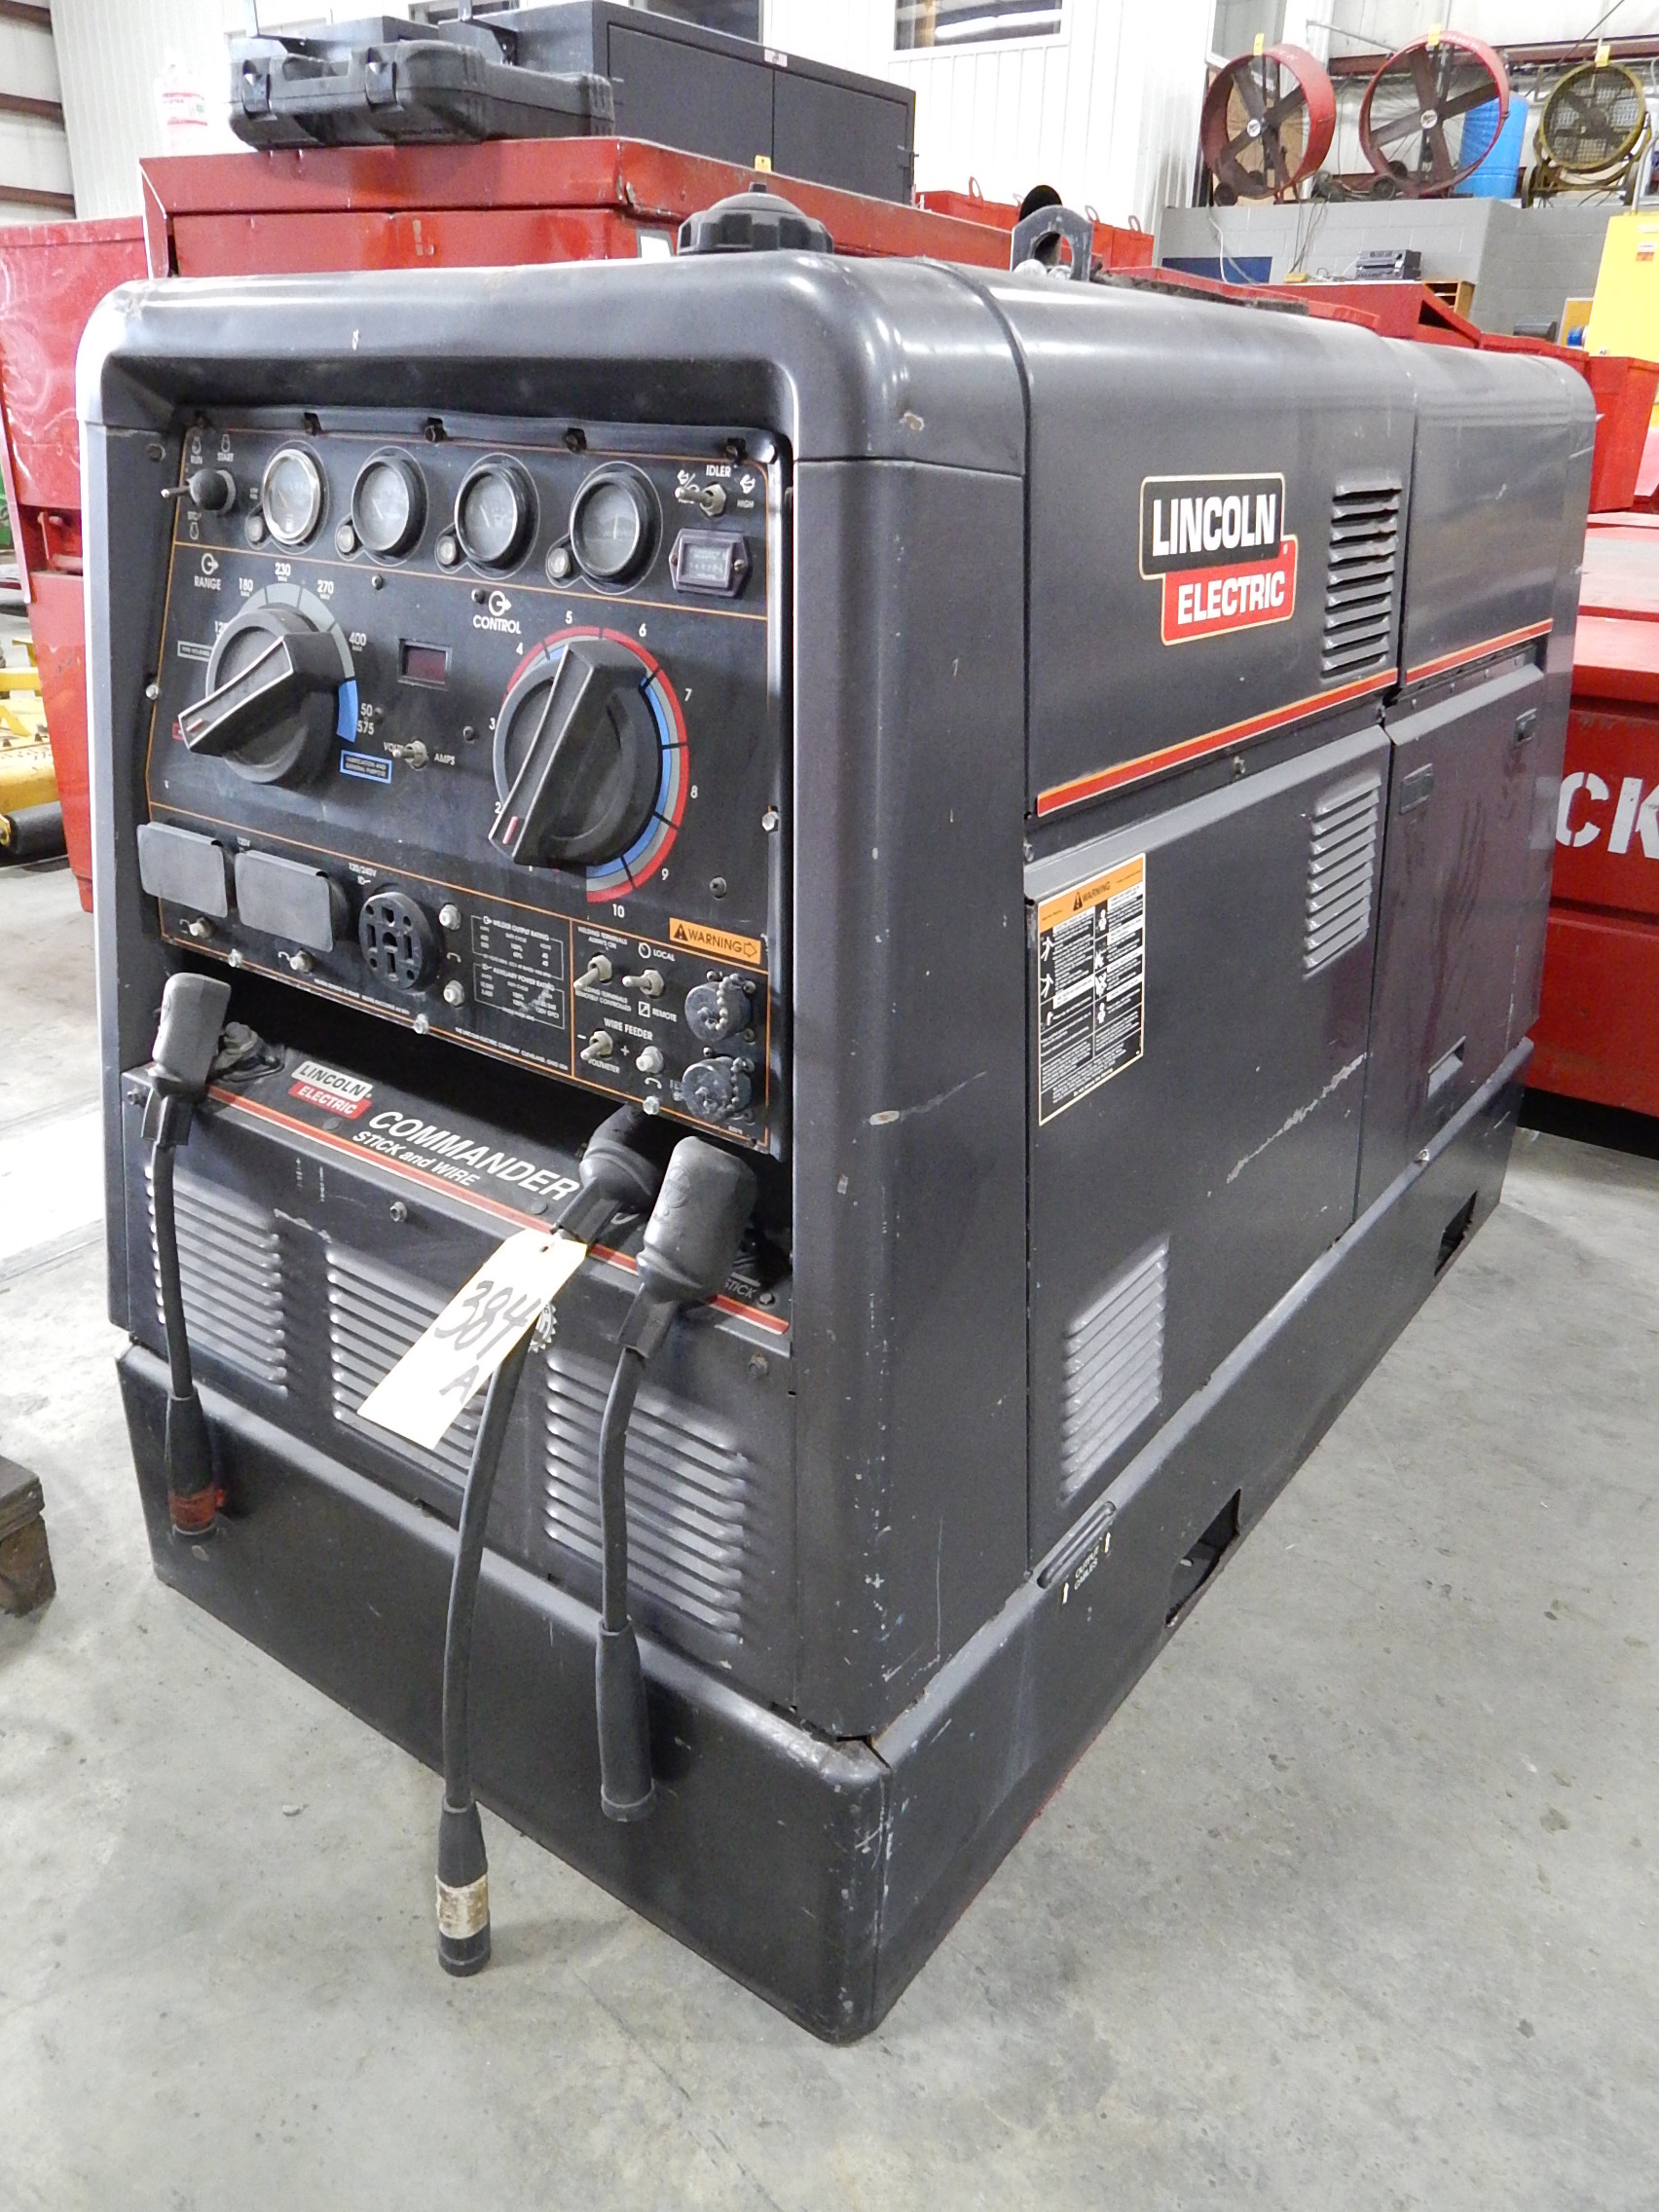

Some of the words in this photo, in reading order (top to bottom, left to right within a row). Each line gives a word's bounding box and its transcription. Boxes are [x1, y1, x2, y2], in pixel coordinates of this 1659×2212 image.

[706, 464, 731, 477] IDLER
[1152, 494, 1276, 557] LINCOLN
[275, 562, 291, 576] 230
[194, 575, 221, 590] RANGE
[239, 577, 254, 592] 180
[316, 579, 334, 595] 270
[1177, 571, 1285, 625] ELECTRIC
[472, 614, 522, 635] CONTROL
[565, 610, 572, 624] 5
[639, 624, 646, 638] 6
[349, 632, 366, 646] 400
[515, 643, 524, 655] 4
[684, 688, 692, 701] 7
[360, 702, 373, 717] 50
[357, 720, 374, 735] 575
[489, 718, 496, 730] 3
[434, 754, 456, 765] AMPS
[690, 786, 698, 798] 8
[495, 802, 501, 814] 2
[661, 868, 669, 881] 9
[1082, 881, 1111, 903] WARNING
[612, 903, 625, 918] 10
[687, 928, 743, 953] WARNING
[653, 948, 676, 962] LOCAL
[651, 1008, 678, 1022] REMOTE
[604, 1017, 623, 1032] WIRE
[624, 1023, 653, 1041] FEEDER
[299, 1064, 366, 1096] LINCOLN
[297, 1086, 357, 1115] ELECTRIC
[352, 1131, 407, 1157] STICK
[398, 1151, 436, 1168] and
[431, 1161, 481, 1186] WIRE
[368, 1111, 580, 1201] COMMANDER
[439, 1365, 480, 1404] A
